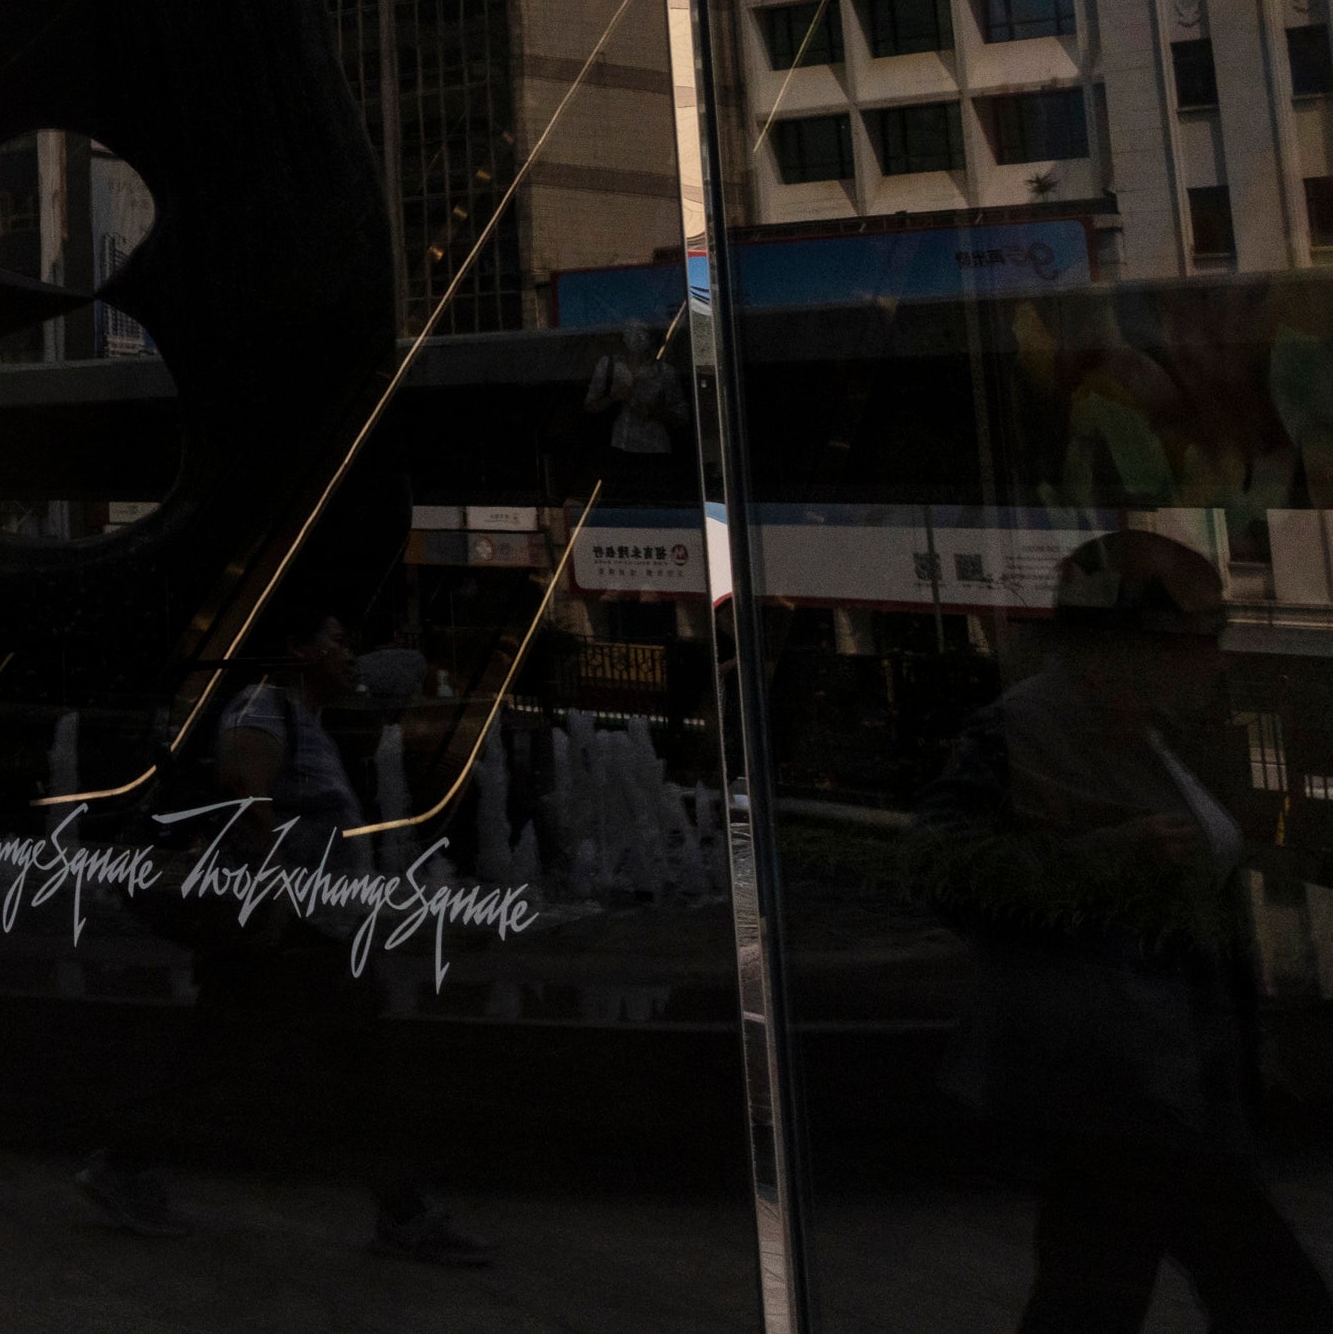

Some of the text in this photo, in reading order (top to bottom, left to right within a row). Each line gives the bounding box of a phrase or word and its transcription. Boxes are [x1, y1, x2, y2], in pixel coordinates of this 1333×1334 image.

[32, 802, 162, 947] Square
[152, 796, 273, 900] Two
[239, 815, 403, 978] Exchange
[385, 837, 539, 994] Square
